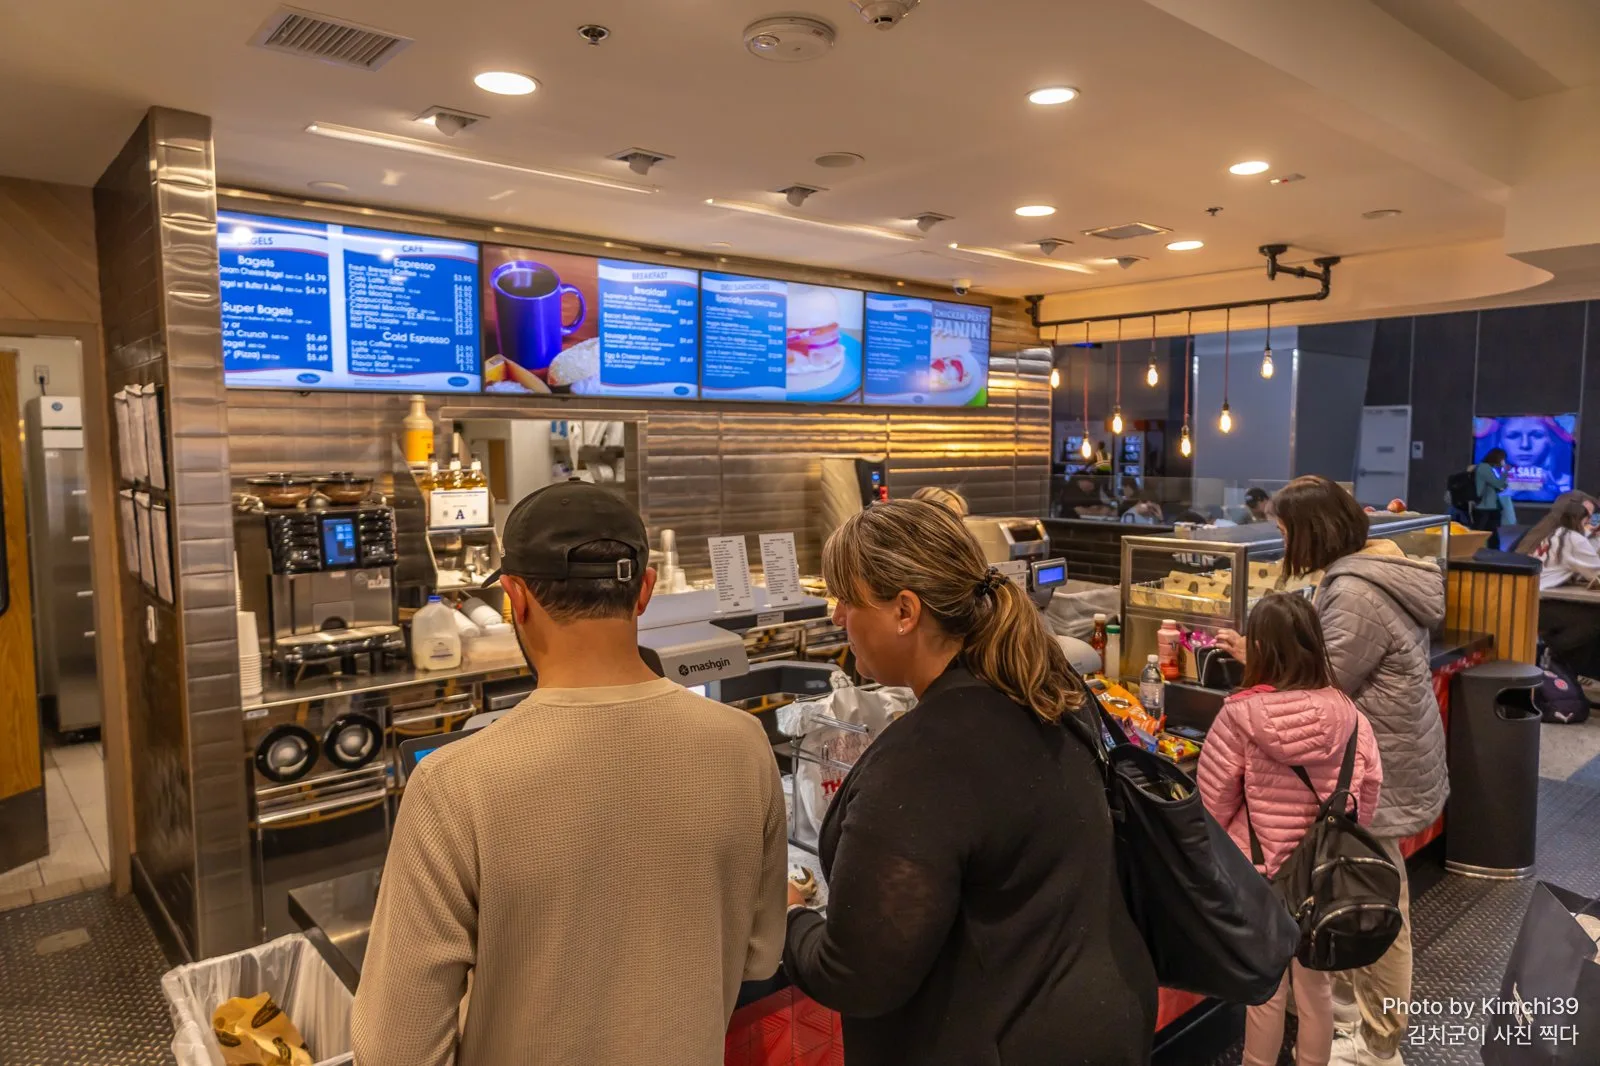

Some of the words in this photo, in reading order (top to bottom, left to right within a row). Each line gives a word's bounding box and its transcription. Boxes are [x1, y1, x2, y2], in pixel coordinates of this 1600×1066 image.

[237, 254, 275, 268] Bagels
[393, 257, 436, 271] Espresso
[305, 272, 327, 282] $4.79
[632, 272, 668, 280] BREAKFAST
[305, 285, 327, 295] $4.79
[634, 286, 667, 297] Breakfast
[222, 301, 255, 313] Super
[257, 304, 294, 317] Bagels
[236, 329, 268, 339] Crunch
[933, 319, 987, 339] PANINI
[383, 331, 407, 342] Cold
[409, 333, 451, 345] Espresso
[1517, 467, 1542, 477] SALE
[456, 509, 465, 520] A
[690, 658, 731, 672] mashgin
